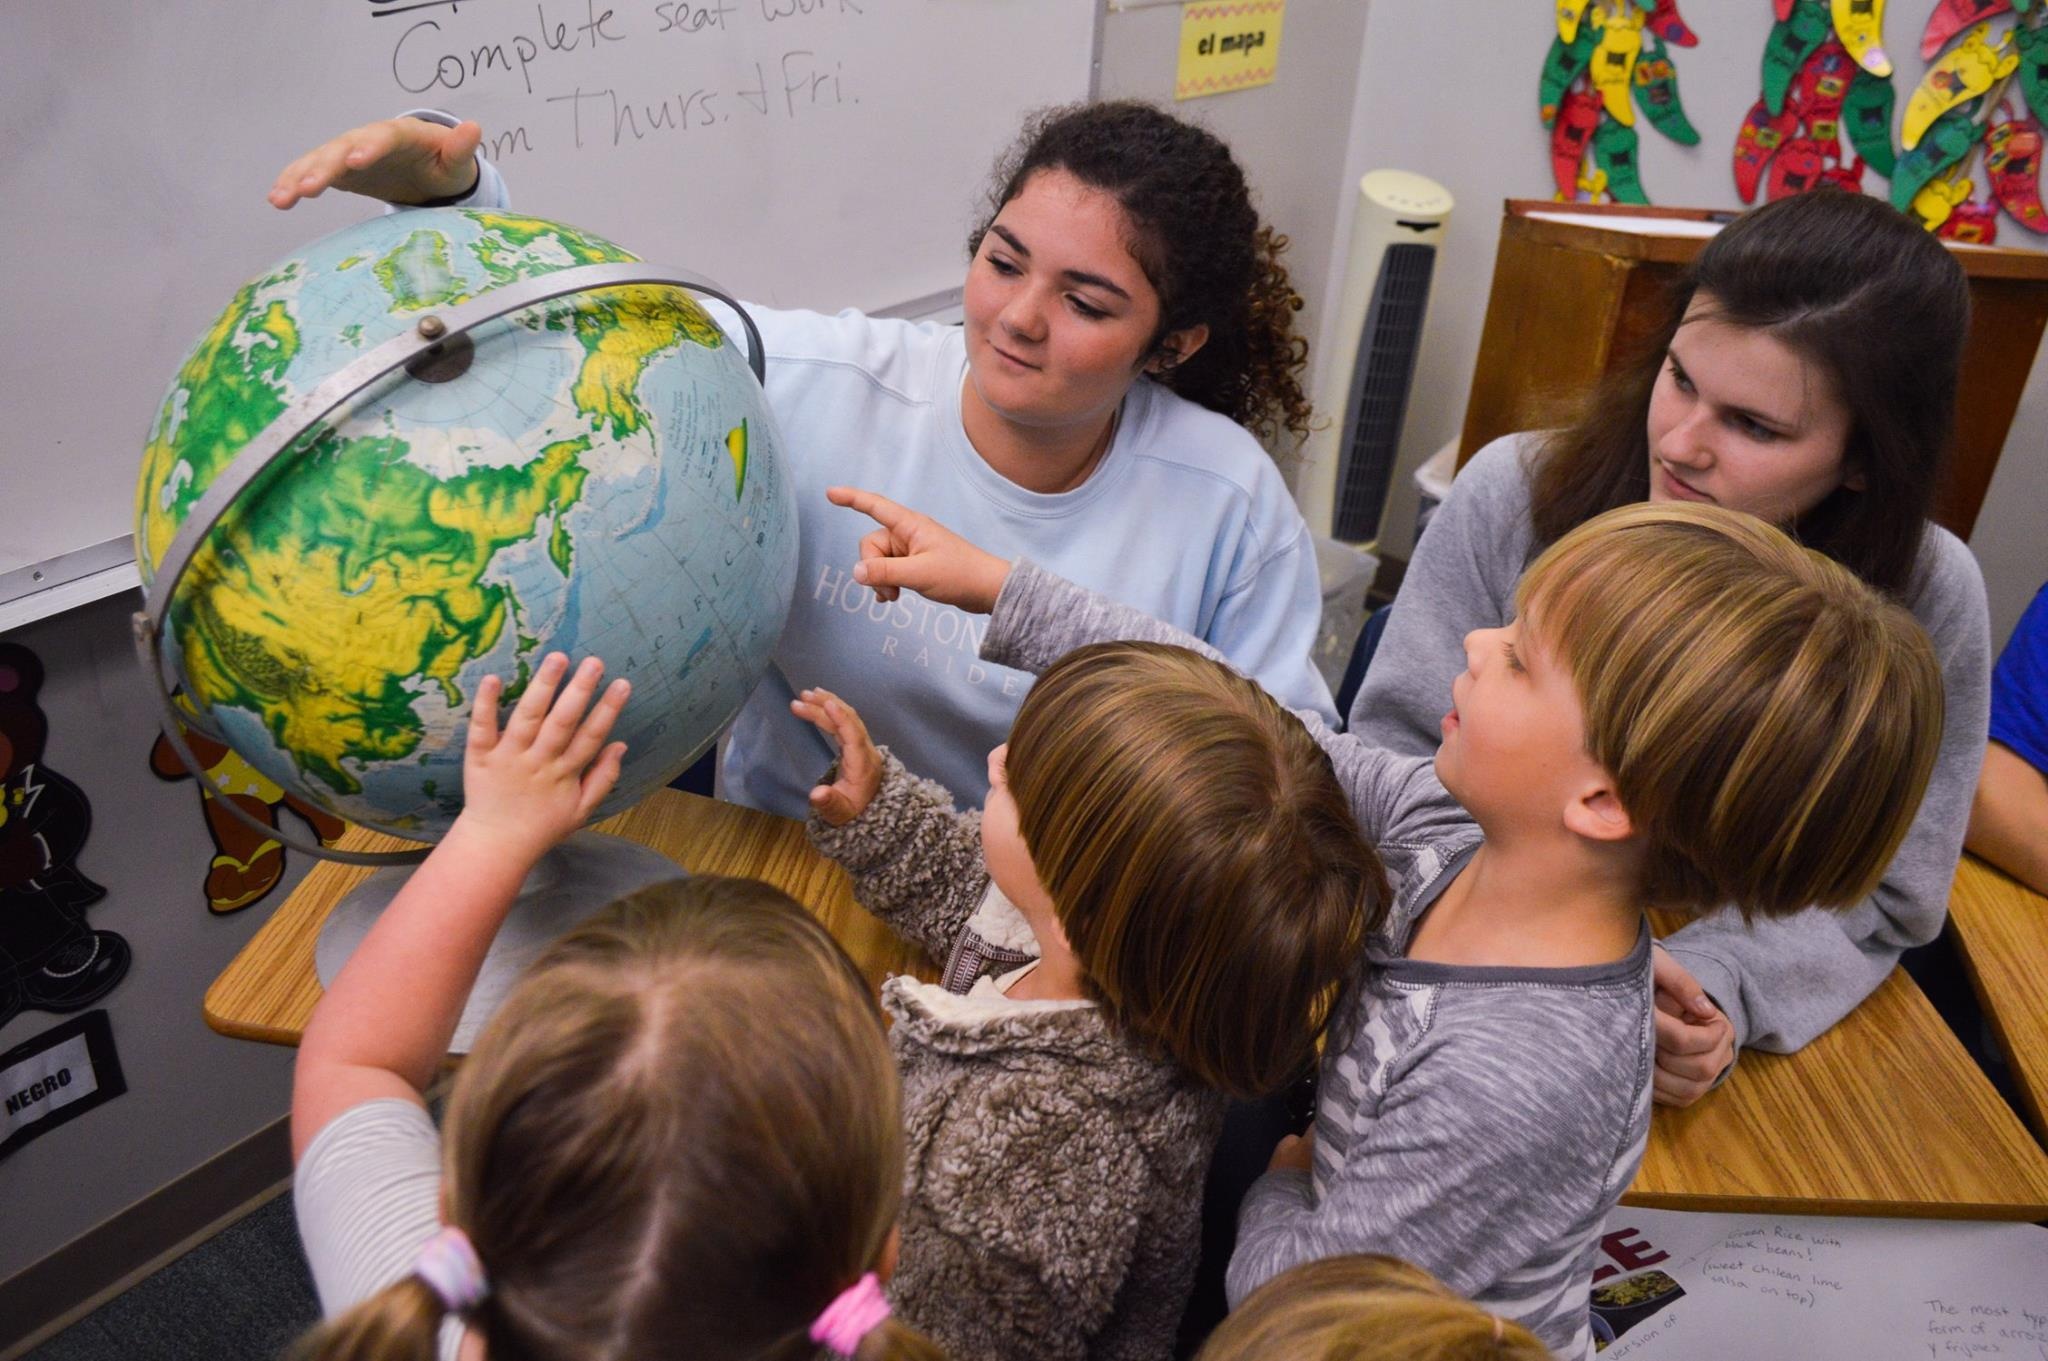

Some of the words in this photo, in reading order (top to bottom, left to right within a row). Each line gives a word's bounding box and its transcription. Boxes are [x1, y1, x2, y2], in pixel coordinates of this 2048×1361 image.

[393, 0, 627, 94] Complete
[655, 0, 737, 33] seat
[1197, 33, 1215, 55] el
[1219, 30, 1265, 56] mapa
[546, 87, 729, 148] Thurs.
[782, 50, 859, 118] Fri.
[4, 1067, 73, 1116] NEGRO
[1774, 1224, 1804, 1241] Rice
[1760, 1286, 1779, 1296] on
[1812, 1274, 1844, 1291] lime
[1923, 1299, 1960, 1316] The
[1969, 1304, 2010, 1317] most
[1663, 1312, 1678, 1329] of
[1928, 1319, 1965, 1335] form
[1970, 1320, 1985, 1335] of
